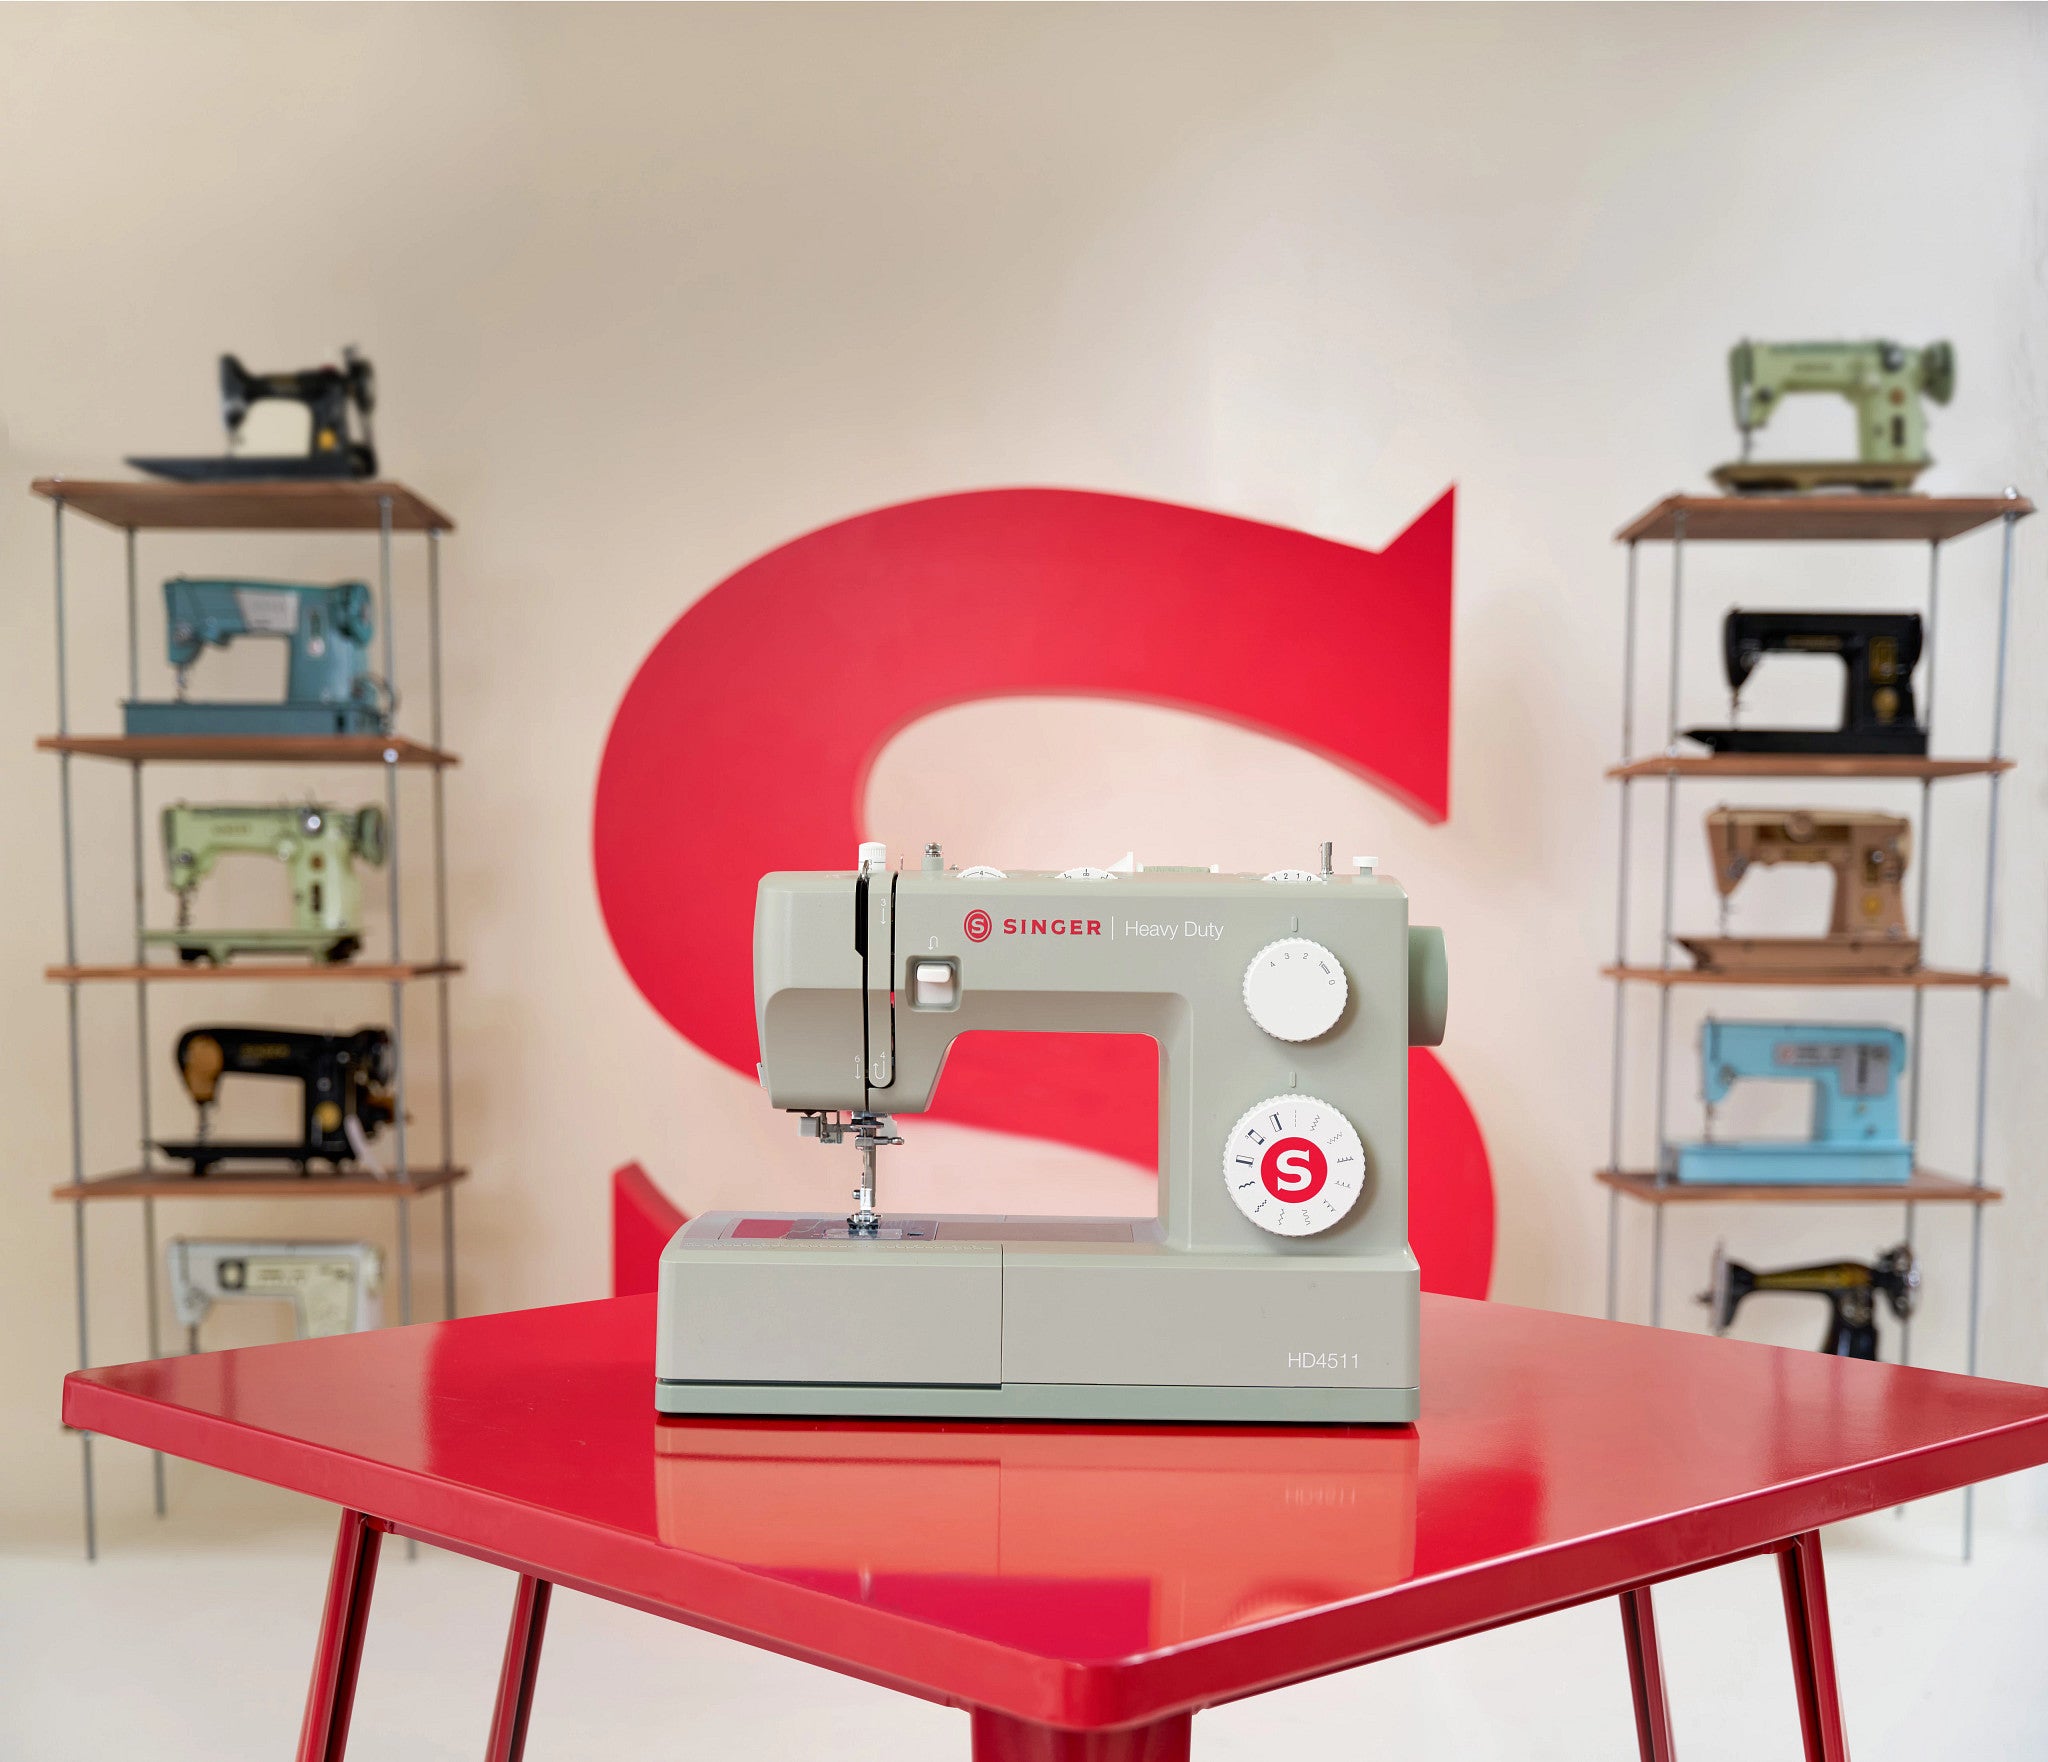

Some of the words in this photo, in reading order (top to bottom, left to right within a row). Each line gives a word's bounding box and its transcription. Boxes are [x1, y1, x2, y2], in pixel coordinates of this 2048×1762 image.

[1283, 872, 1288, 880] 2
[880, 898, 887, 907] 3
[1003, 918, 1101, 936] SINGER
[1125, 920, 1178, 941] Heavy
[1184, 920, 1225, 941] Duty
[1284, 952, 1290, 960] 3
[1302, 952, 1309, 960] 2
[854, 1054, 861, 1063] 6
[880, 1051, 886, 1060] 4
[1276, 1149, 1313, 1192] S
[1287, 1351, 1360, 1370] HD4511
